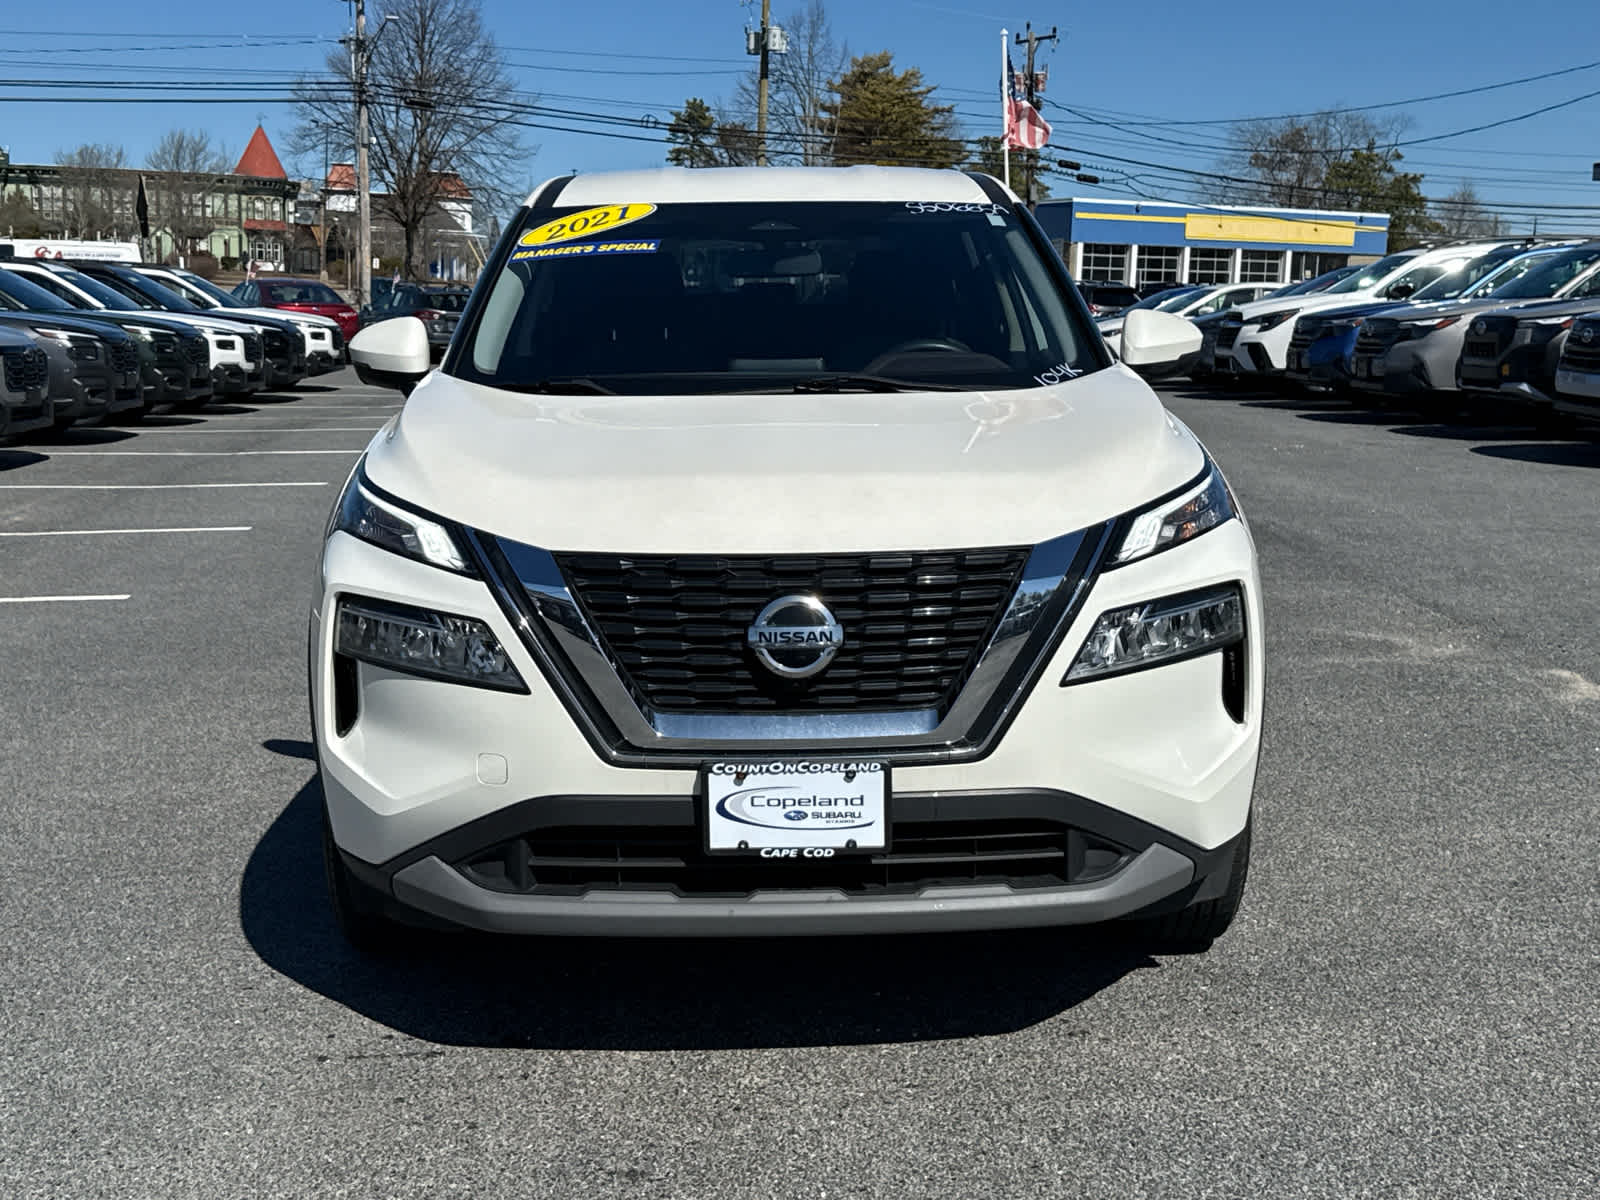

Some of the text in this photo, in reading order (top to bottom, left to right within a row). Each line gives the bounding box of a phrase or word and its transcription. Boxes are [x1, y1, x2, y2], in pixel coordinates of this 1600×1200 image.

[547, 206, 631, 241] 2021
[512, 242, 656, 260] MANAGER'S SPECIAL
[1033, 362, 1083, 386] 104K
[758, 631, 833, 643] NISSAN
[750, 795, 864, 809] Copeland
[811, 811, 862, 819] SUBARU
[760, 848, 835, 858] CAPE COD
